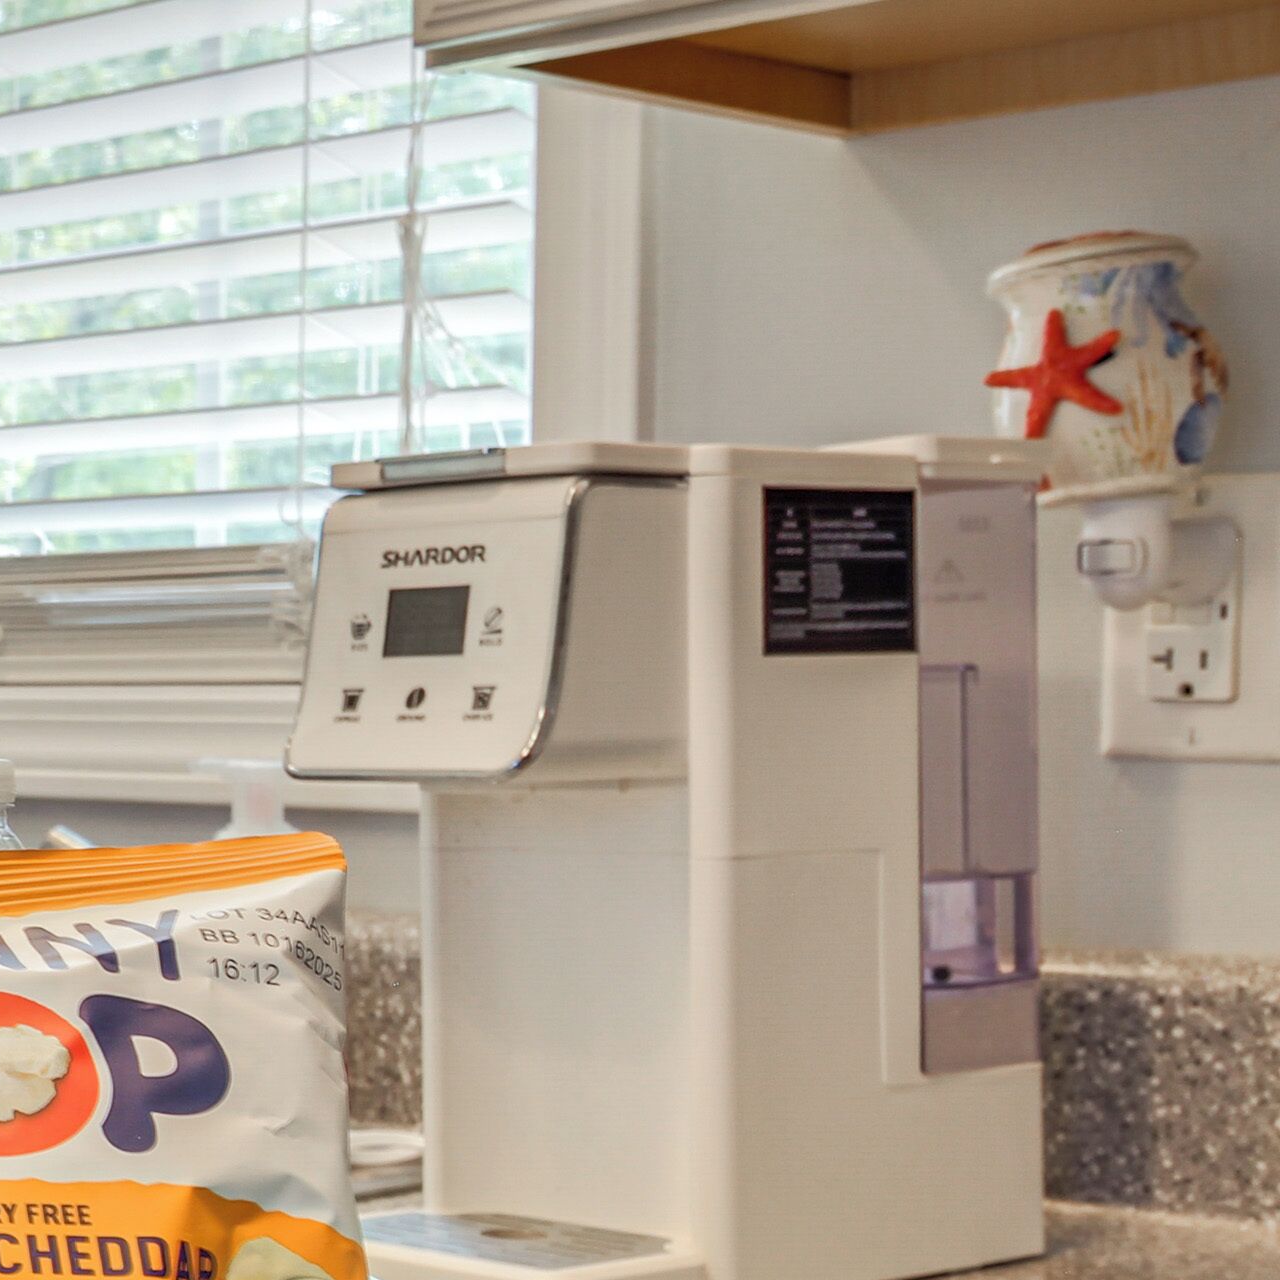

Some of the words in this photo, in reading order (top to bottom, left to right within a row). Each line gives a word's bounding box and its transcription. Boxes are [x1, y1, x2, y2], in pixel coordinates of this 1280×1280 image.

[380, 545, 486, 569] SHARDOR
[198, 927, 241, 945] BB
[246, 930, 344, 991] 10162025
[208, 957, 281, 987] 16:12
[26, 1204, 93, 1226] FREE
